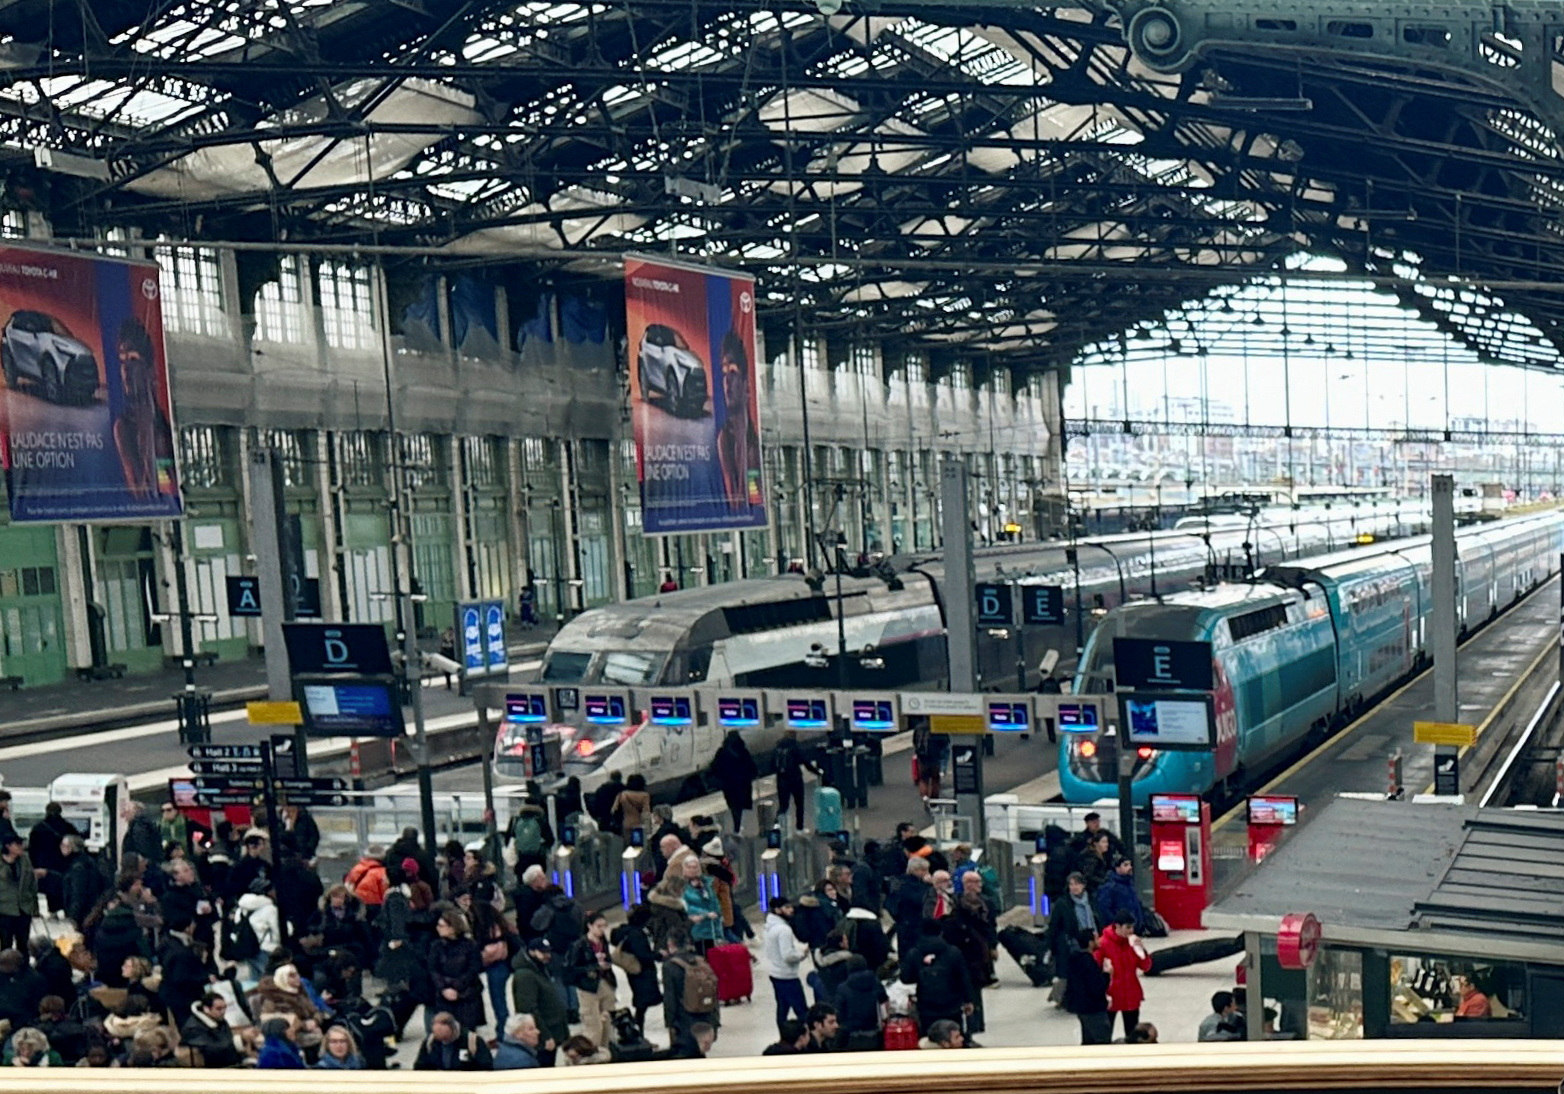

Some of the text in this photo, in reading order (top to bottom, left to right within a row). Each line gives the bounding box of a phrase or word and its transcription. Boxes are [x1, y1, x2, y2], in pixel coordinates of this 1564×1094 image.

[87, 433, 104, 450] PAS
[11, 452, 75, 469] UNE OPTION
[240, 589, 257, 607] A
[983, 596, 1000, 615] D
[1036, 598, 1051, 616] E
[324, 639, 349, 663] D
[1154, 655, 1172, 678] E
